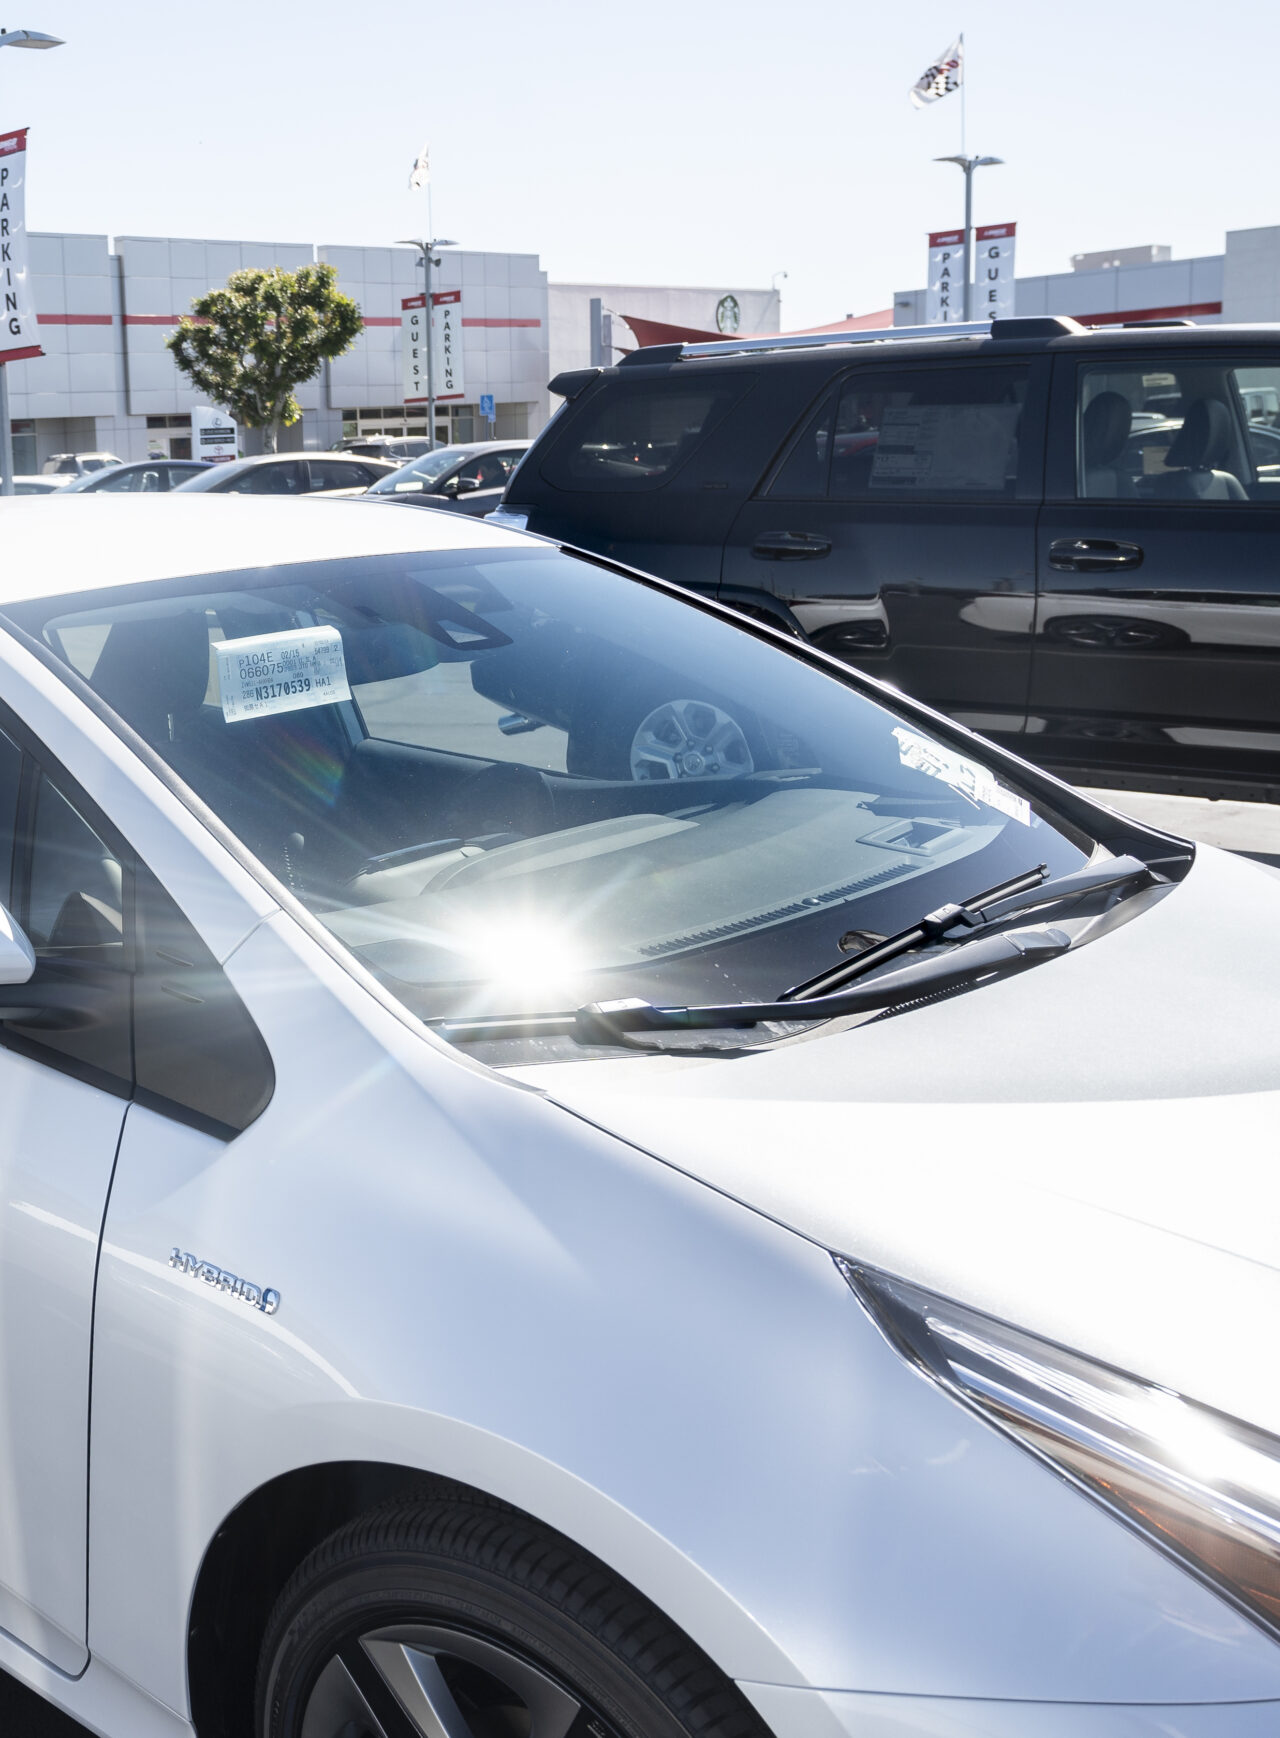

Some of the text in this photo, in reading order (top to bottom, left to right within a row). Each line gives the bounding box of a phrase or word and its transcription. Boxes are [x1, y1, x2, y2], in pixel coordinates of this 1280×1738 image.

[0, 167, 21, 336] PARKING
[940, 252, 951, 322] PARKI
[987, 246, 1000, 320] GUES
[410, 315, 420, 392] GUEST
[443, 310, 454, 390] PARKING
[239, 662, 285, 680] 066075
[255, 678, 311, 701] N3170539
[168, 1247, 263, 1307] HYBRID
